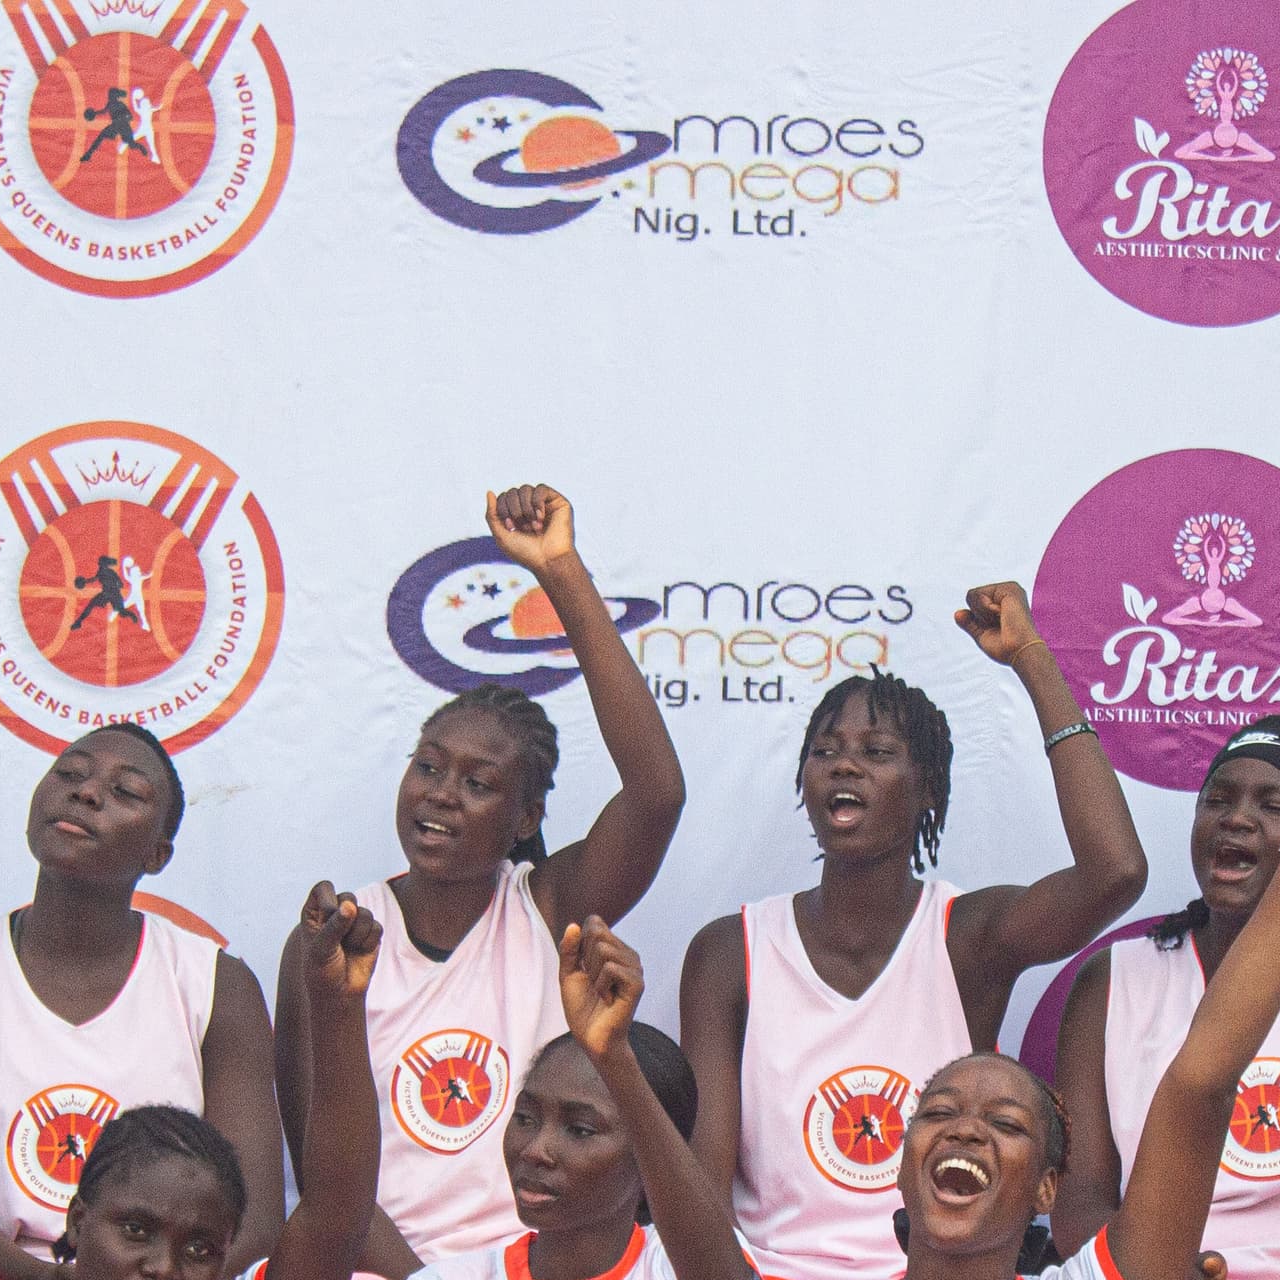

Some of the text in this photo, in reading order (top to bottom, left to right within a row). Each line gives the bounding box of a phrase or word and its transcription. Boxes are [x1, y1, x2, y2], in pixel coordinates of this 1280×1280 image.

[11, 190, 82, 252] QUEENS
[87, 214, 218, 261] BASKETBALL
[215, 73, 257, 214] FOUNDATION
[647, 162, 901, 217] mega
[632, 207, 808, 242] Nig. Ltd.
[1092, 242, 1271, 262] AESTHETICSCLINIC
[1, 659, 73, 720] QUEENS
[205, 541, 248, 681] FOUNDATION
[637, 628, 889, 684] mega
[646, 672, 795, 707] ig. Ltd.
